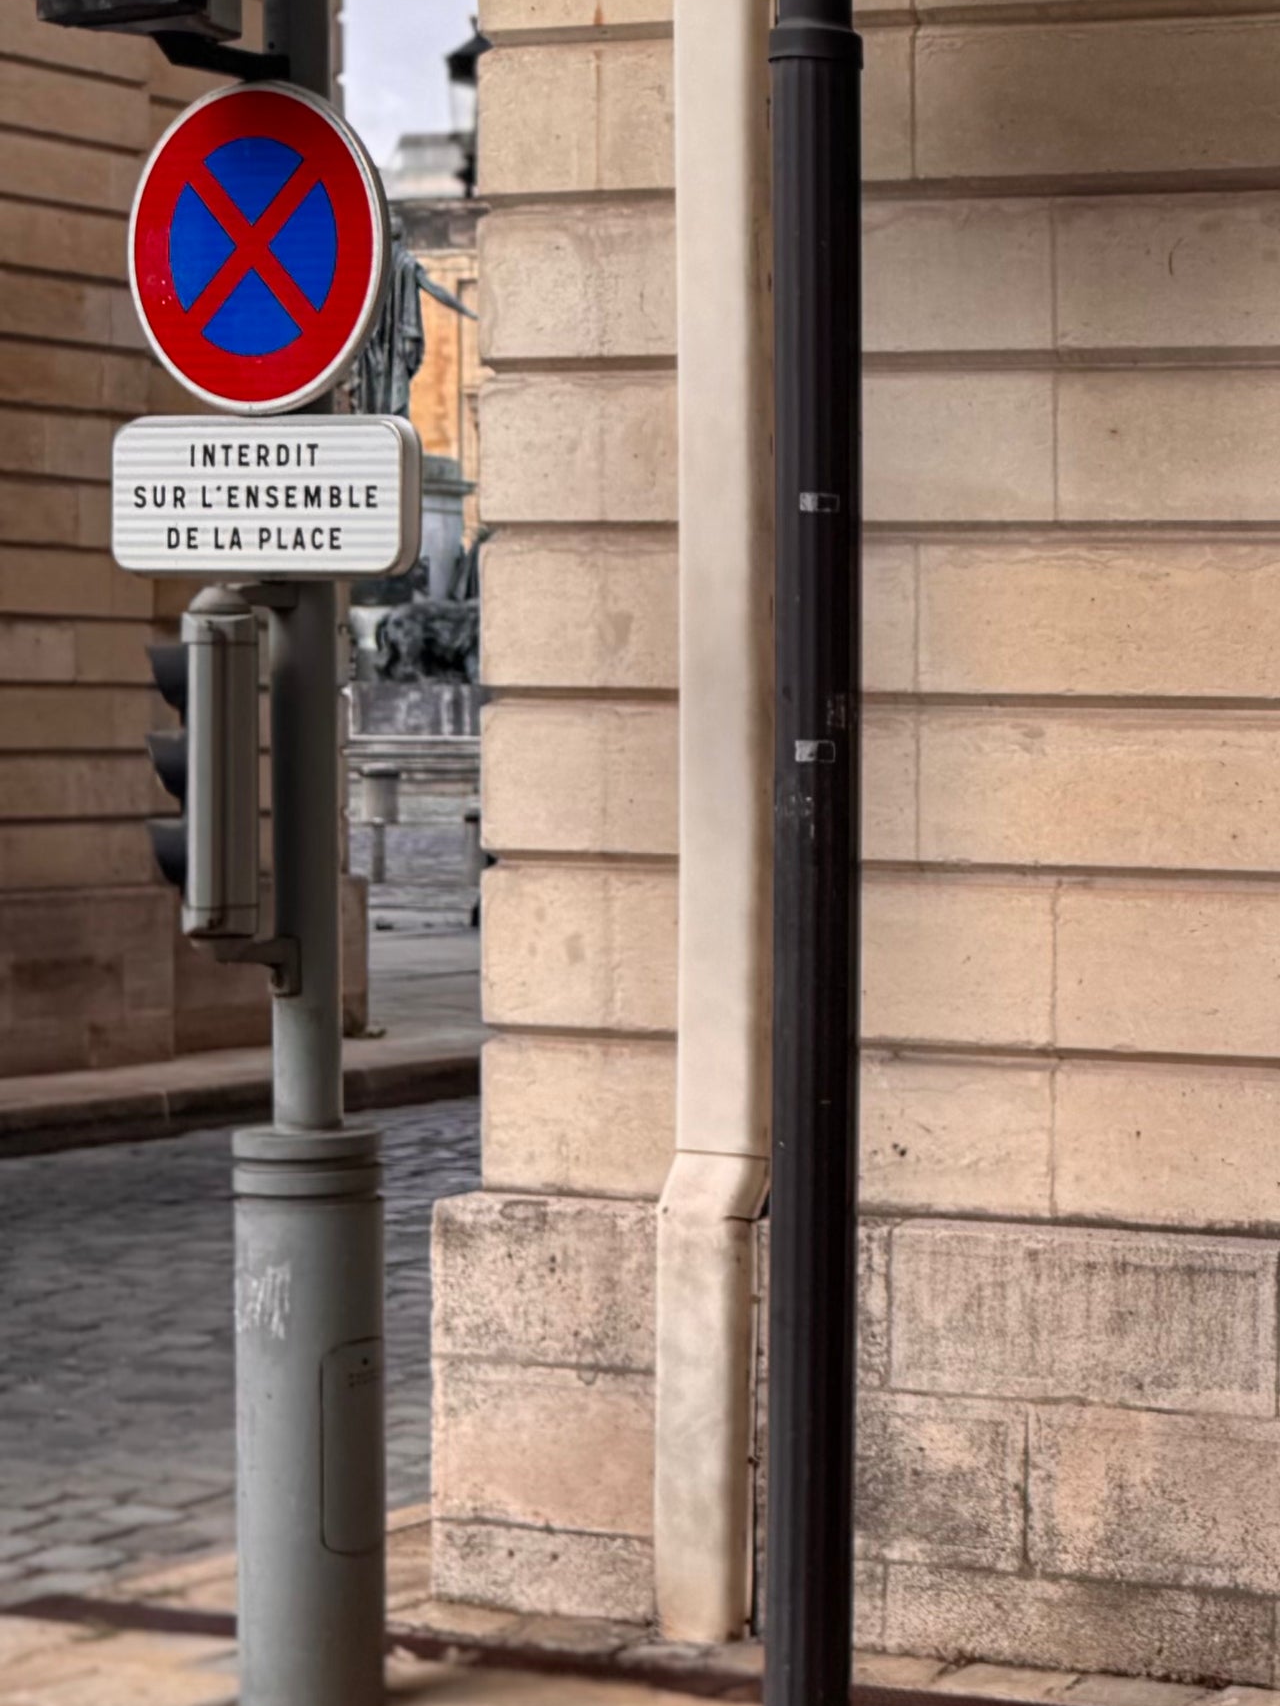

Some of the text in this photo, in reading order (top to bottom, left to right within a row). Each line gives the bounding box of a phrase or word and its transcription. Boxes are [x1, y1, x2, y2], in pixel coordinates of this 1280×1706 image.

[189, 443, 320, 468] INTERDIT
[133, 484, 379, 509] SUR L'ENSEMBLE
[166, 526, 343, 551] DE LA PLACE
